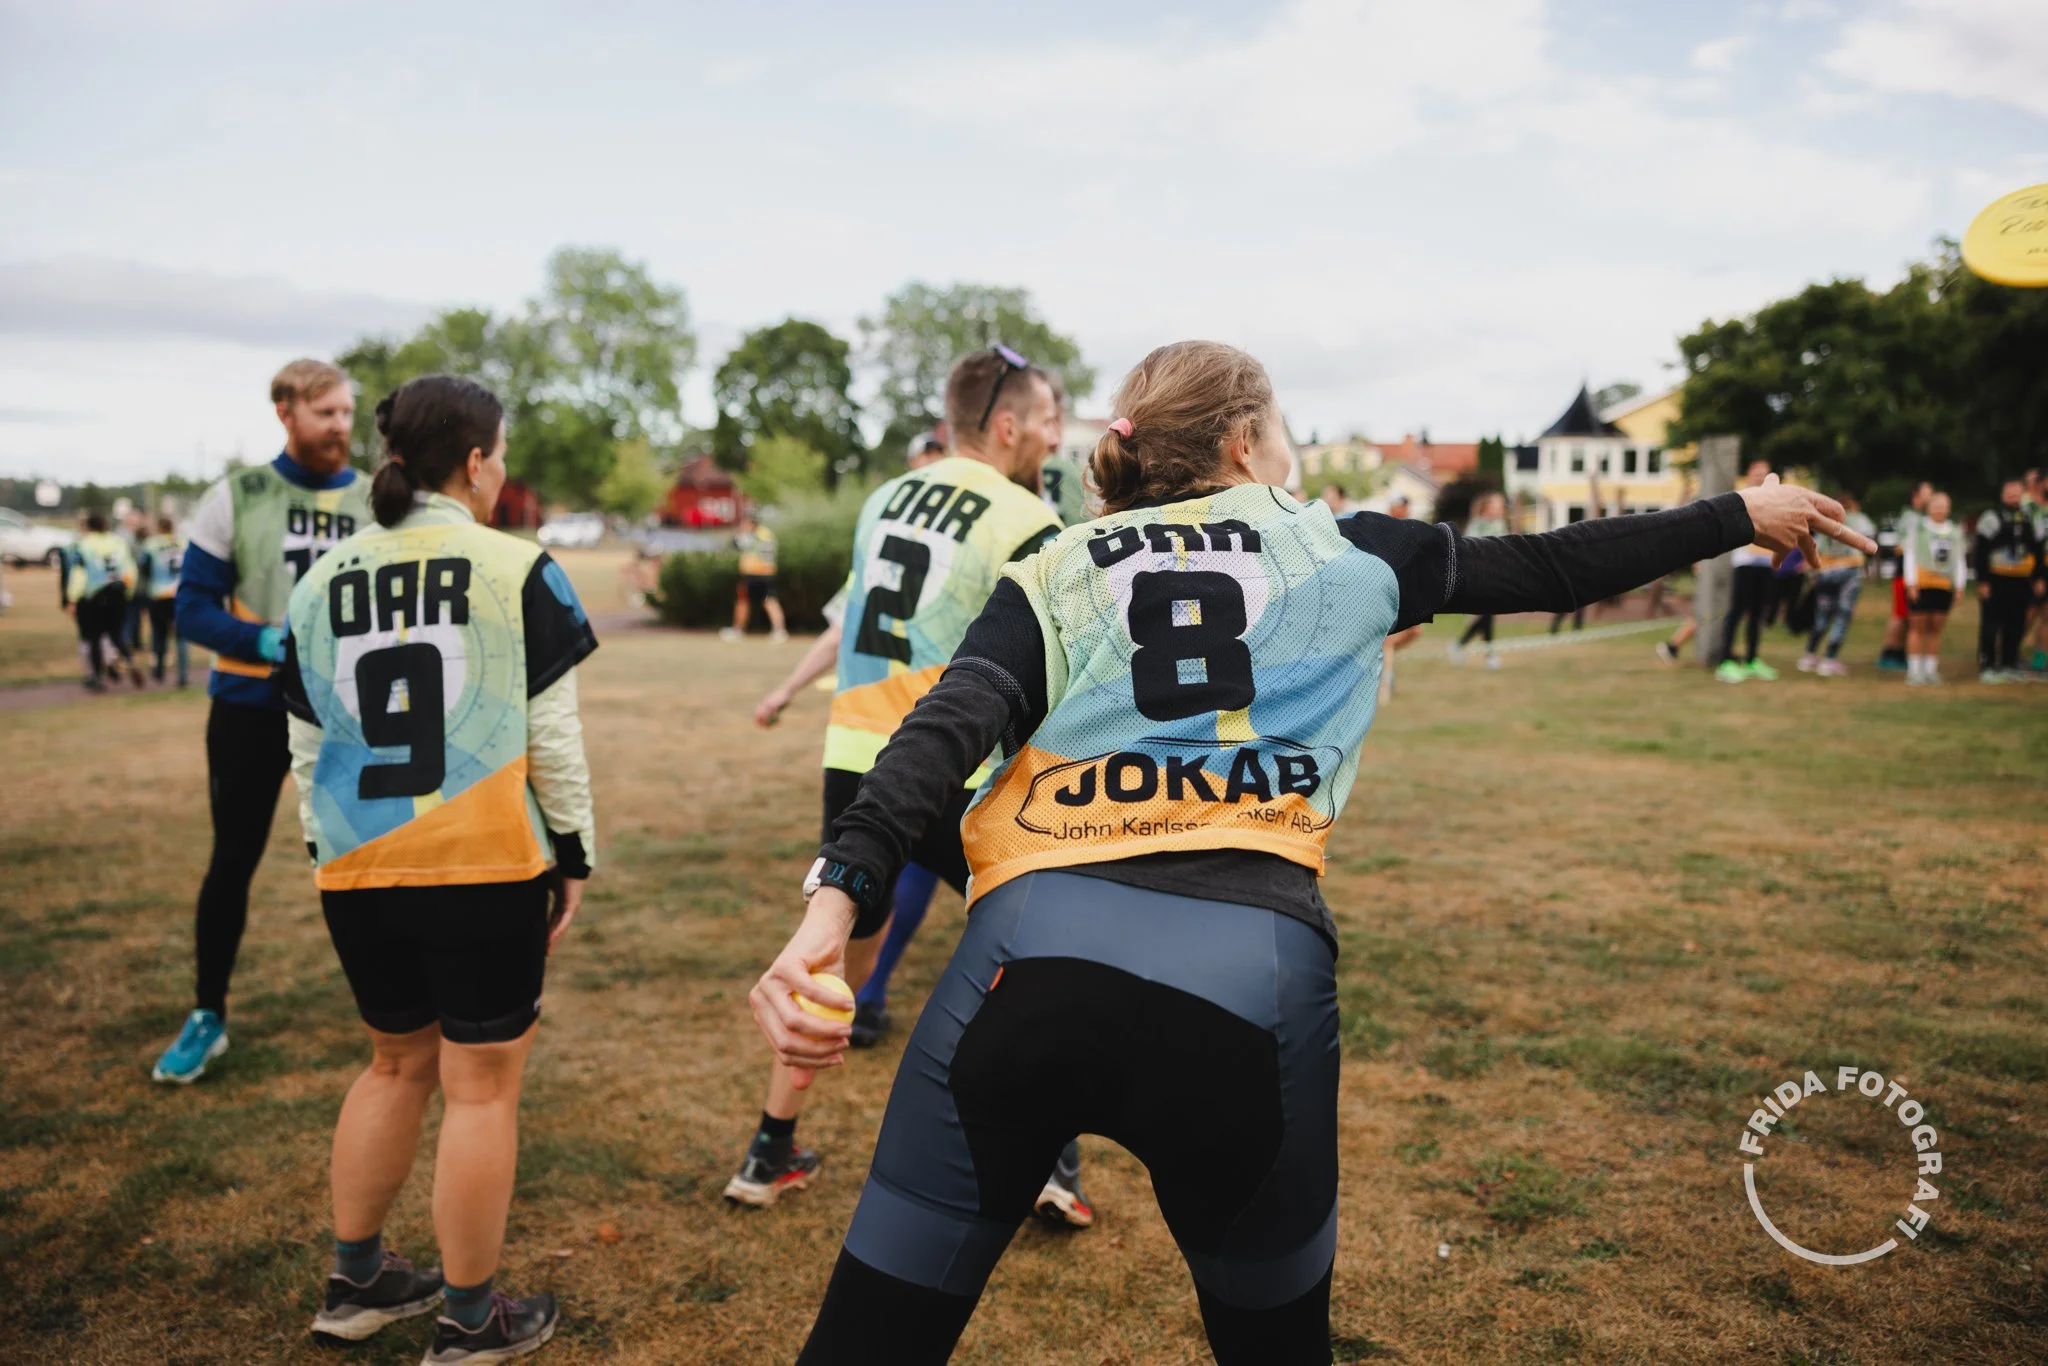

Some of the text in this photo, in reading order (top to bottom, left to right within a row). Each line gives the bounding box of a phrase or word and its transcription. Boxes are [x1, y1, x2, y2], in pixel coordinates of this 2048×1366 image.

[329, 556, 472, 639] ÖAR
[854, 533, 931, 666] 2
[1127, 569, 1257, 723] 8
[355, 642, 447, 801] 9
[1053, 820, 1112, 840] John
[1290, 811, 1314, 834] AB
[1054, 746, 1321, 807] JOKAB
